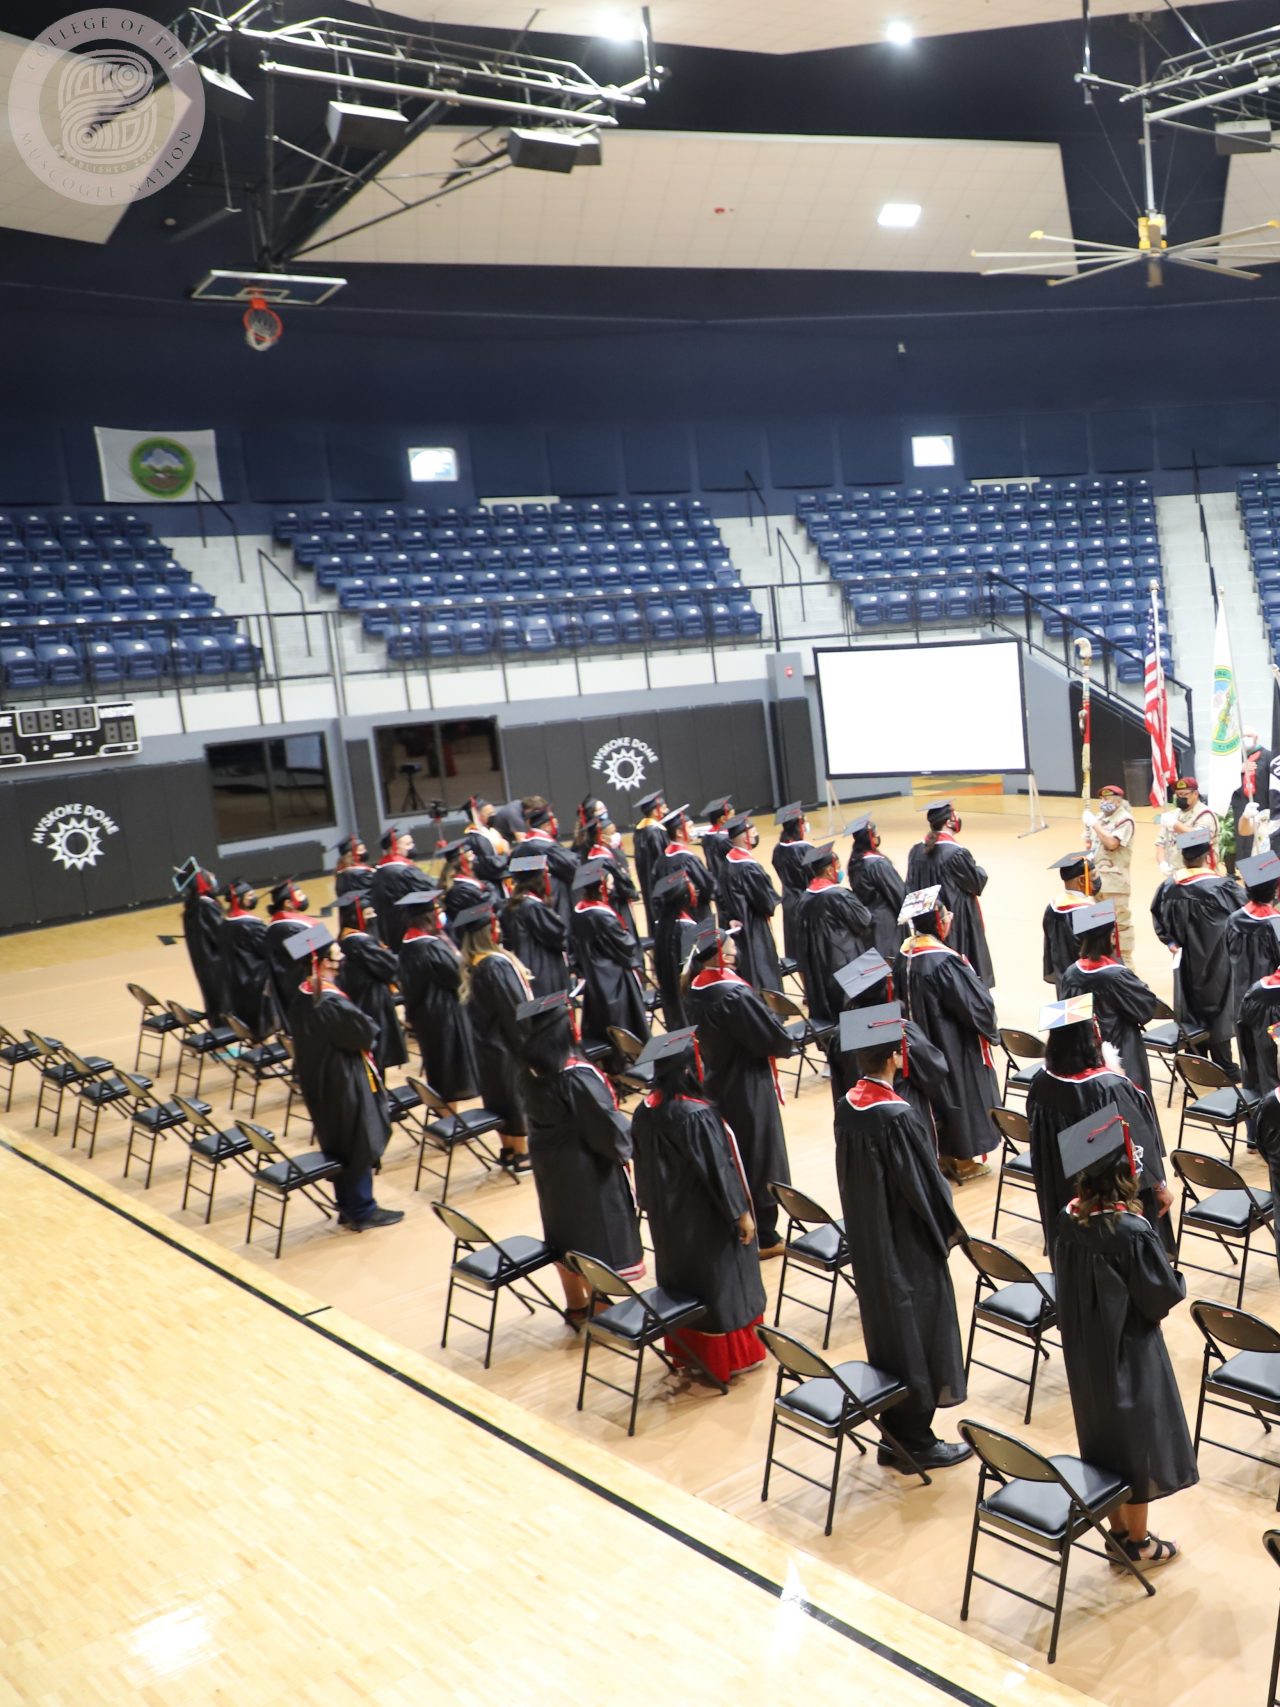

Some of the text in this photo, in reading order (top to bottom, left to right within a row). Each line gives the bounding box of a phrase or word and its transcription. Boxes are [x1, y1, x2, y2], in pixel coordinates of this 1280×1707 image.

[591, 737, 659, 770] MVSKOKE DOME
[32, 803, 120, 844] MVSKOKE DOME
